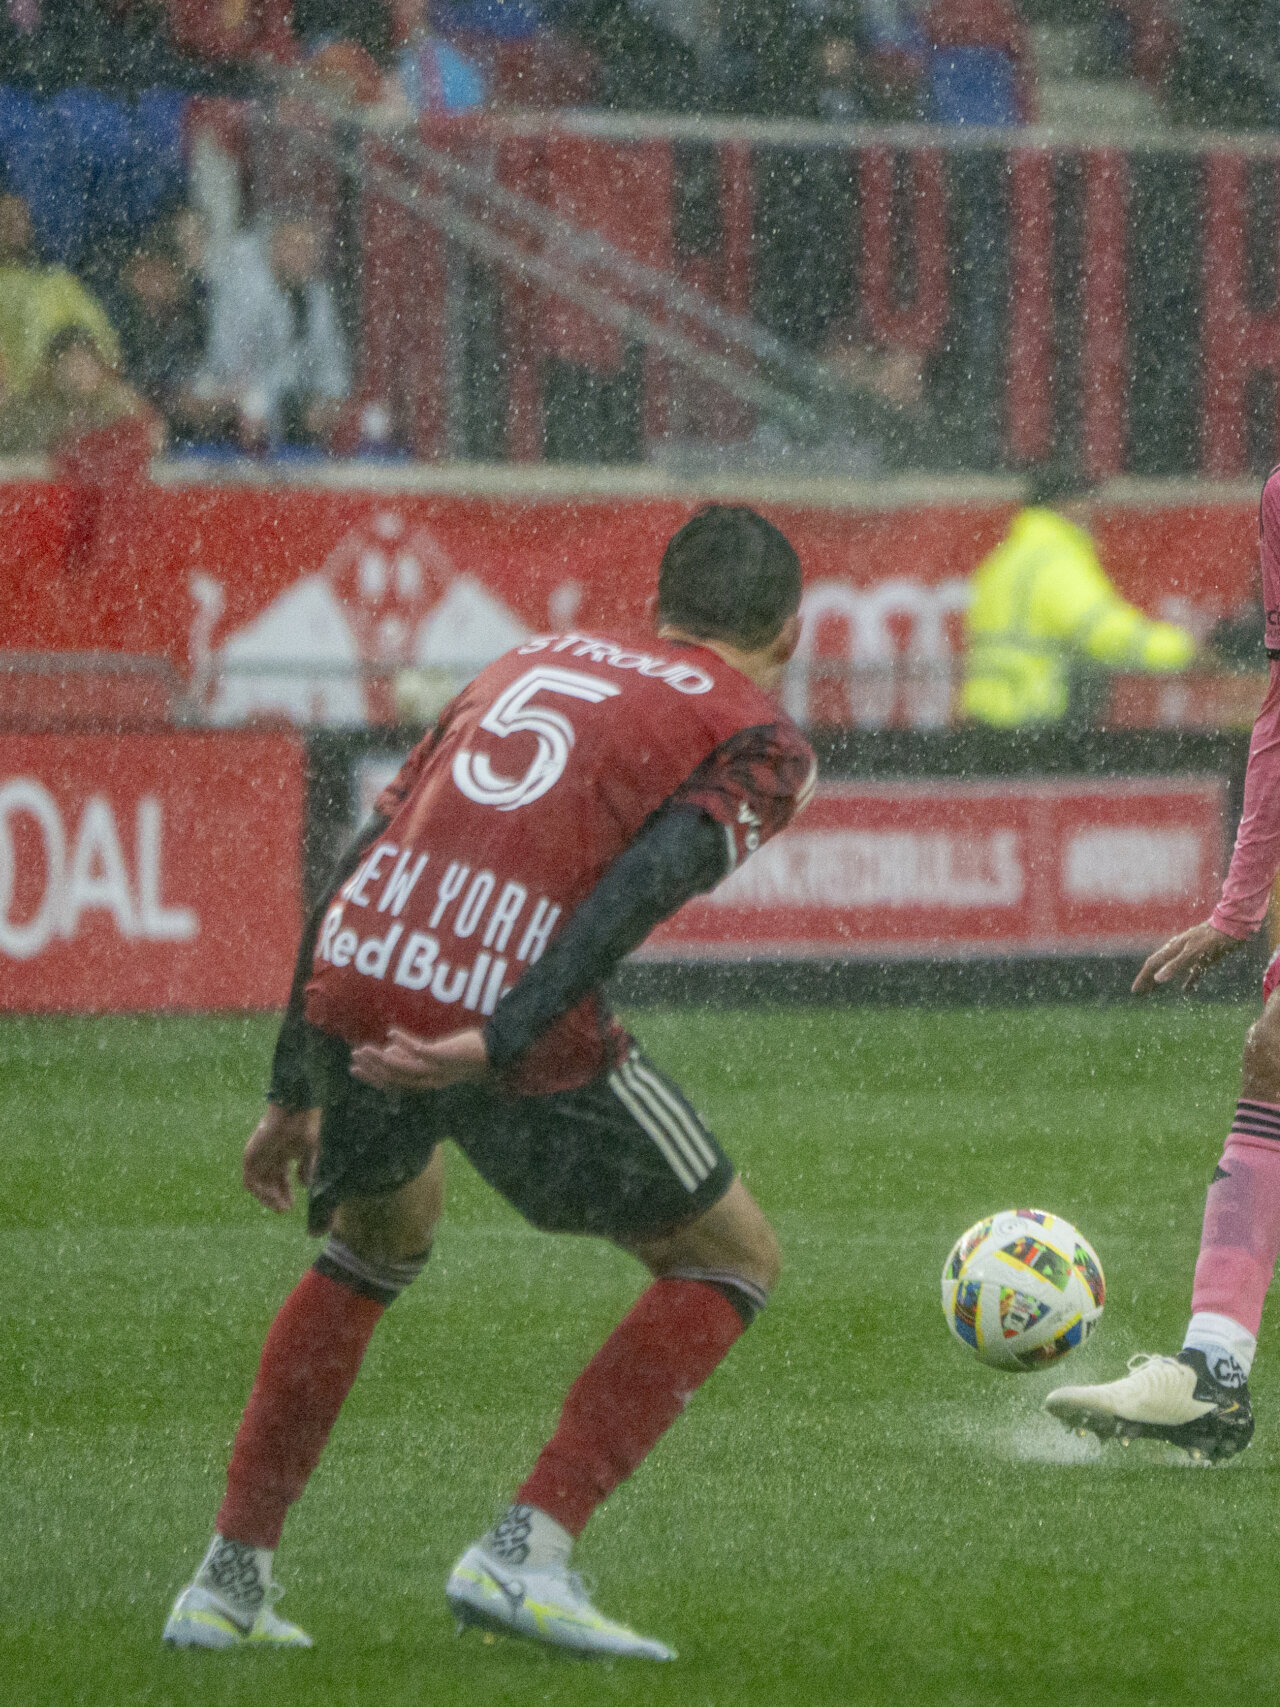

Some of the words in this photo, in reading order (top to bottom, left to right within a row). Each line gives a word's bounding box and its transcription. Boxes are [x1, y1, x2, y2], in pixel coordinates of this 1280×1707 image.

[517, 633, 714, 694] STROUD
[452, 664, 622, 811] 5
[316, 903, 404, 981] Red
[394, 931, 513, 1016] Bull
[429, 859, 562, 966] YORK
